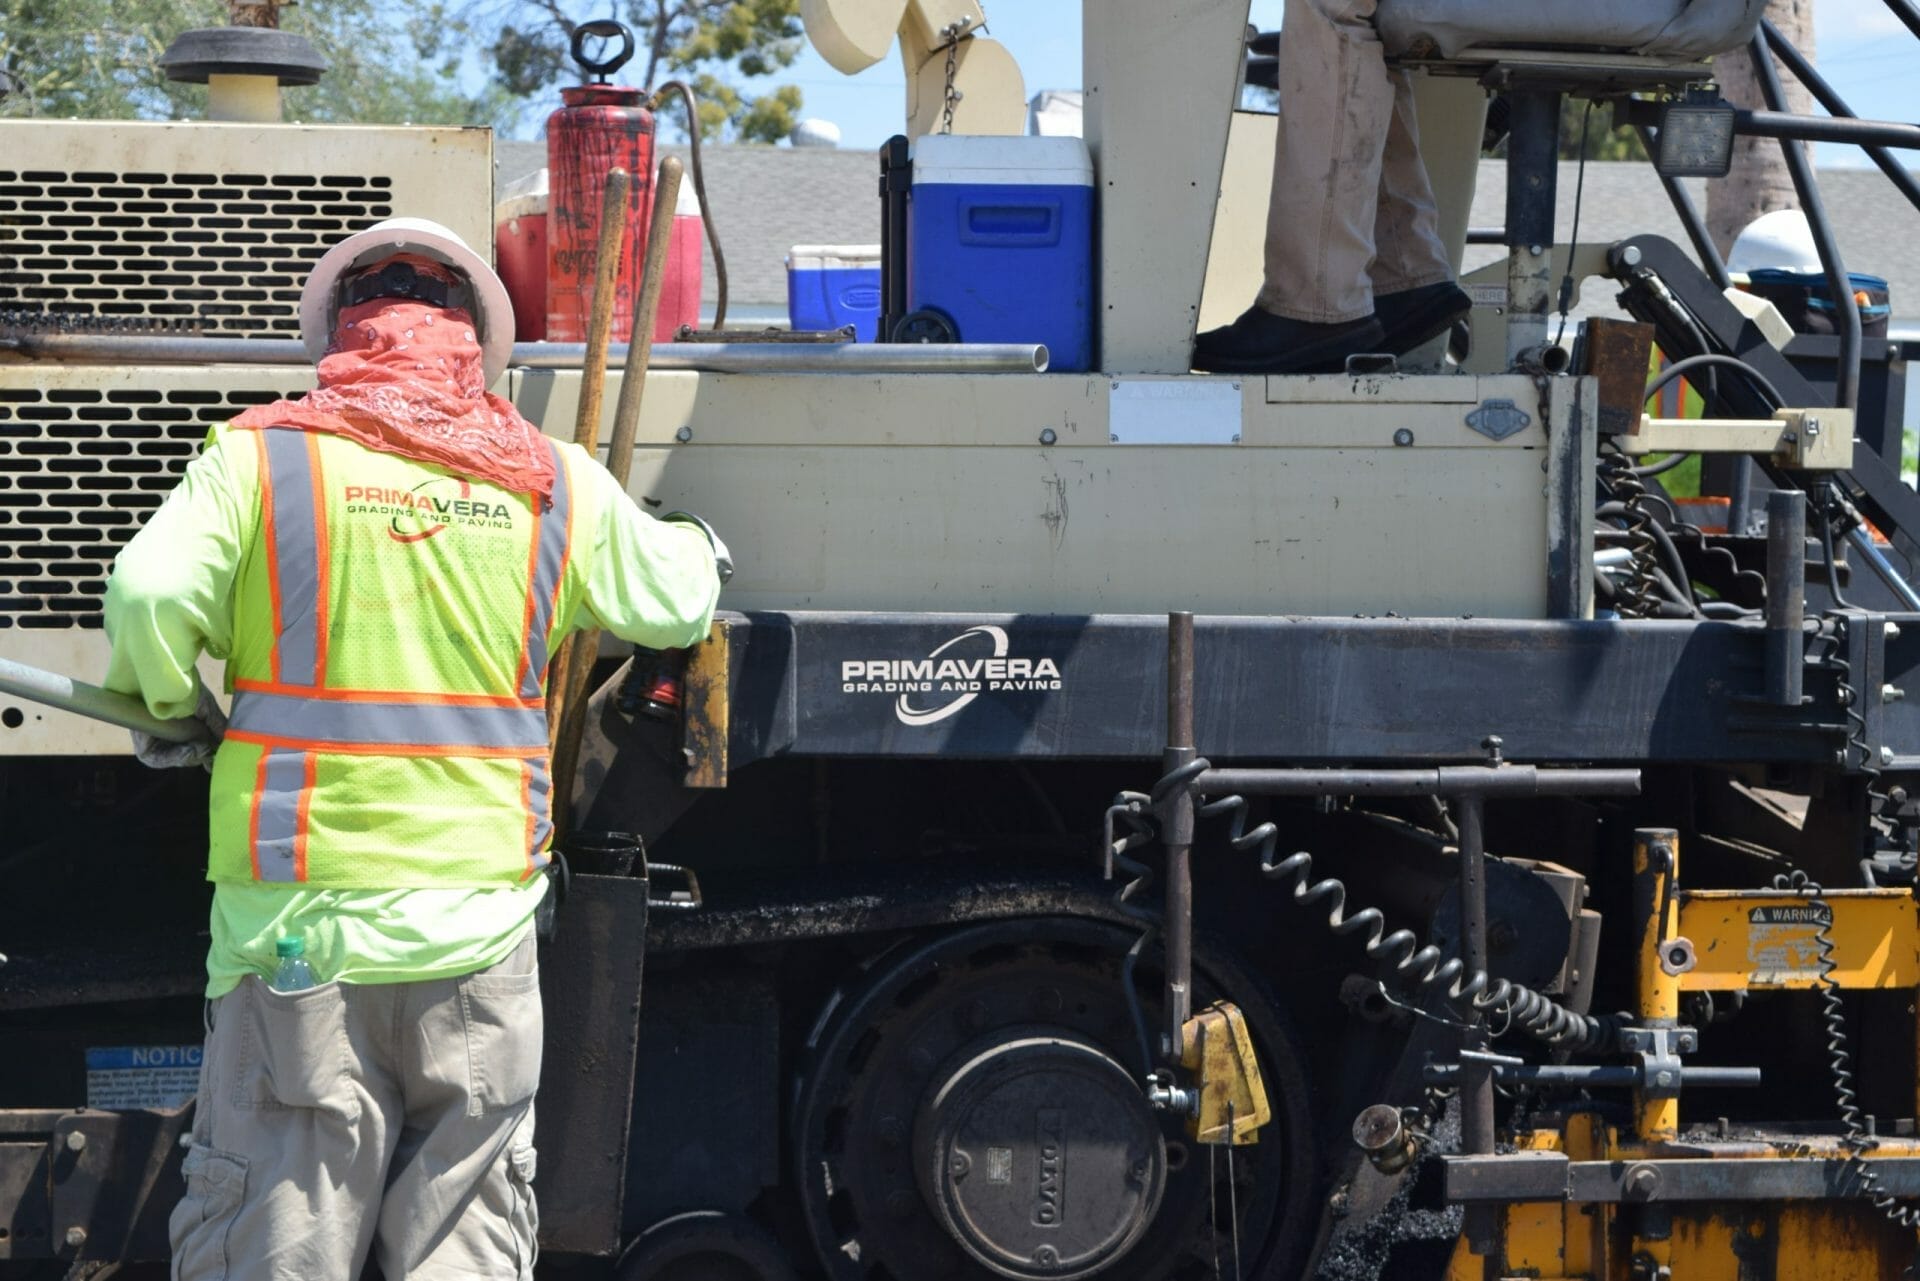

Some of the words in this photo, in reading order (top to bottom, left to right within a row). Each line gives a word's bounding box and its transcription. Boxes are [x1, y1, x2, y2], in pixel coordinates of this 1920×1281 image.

[345, 486, 511, 519] PRIMAVERA
[347, 505, 413, 517] GRADING
[421, 513, 451, 523] AND
[458, 517, 512, 529] PAVING
[842, 658, 1061, 681] PRIMAVERA
[843, 682, 932, 692] GRADING
[940, 681, 981, 691] AND
[989, 680, 1062, 690] PAVING
[1772, 908, 1831, 921] WARNIG
[132, 1047, 201, 1066] NOTIC
[1038, 1119, 1059, 1223] VOLVO
